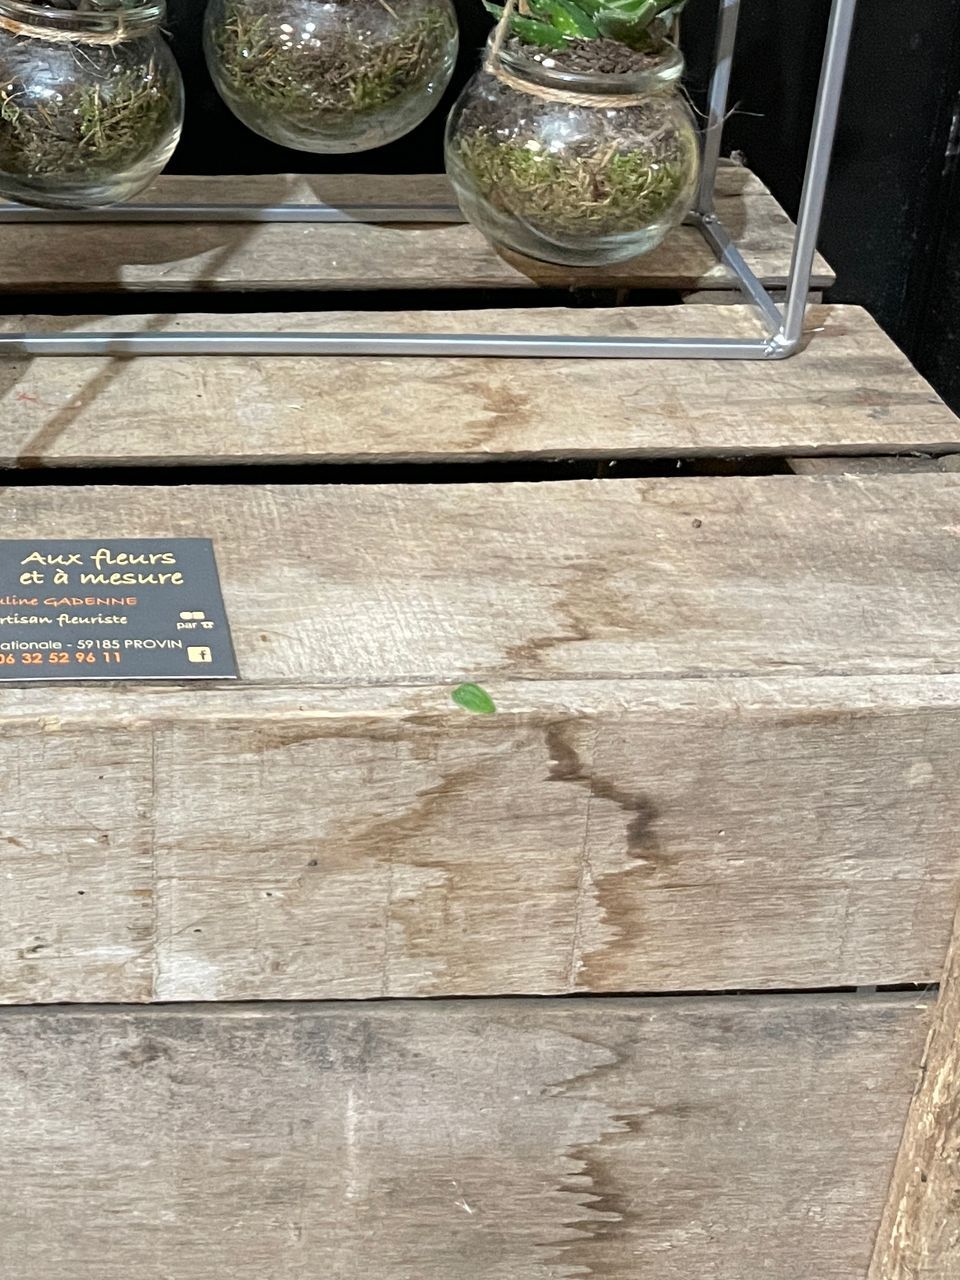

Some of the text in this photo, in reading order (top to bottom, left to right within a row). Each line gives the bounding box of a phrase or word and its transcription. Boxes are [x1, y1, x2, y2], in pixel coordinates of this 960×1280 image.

[21, 548, 176, 570] Aux fleurs
[19, 568, 184, 585] et à mesure
[43, 596, 138, 607] GADENNE
[56, 613, 128, 627] fleuriste
[176, 621, 197, 630] par
[76, 639, 121, 649] 59185
[124, 639, 183, 649] PROVIN
[21, 652, 43, 664] 32
[48, 652, 70, 664] 52
[75, 652, 96, 663] 96
[104, 652, 121, 663] 11
